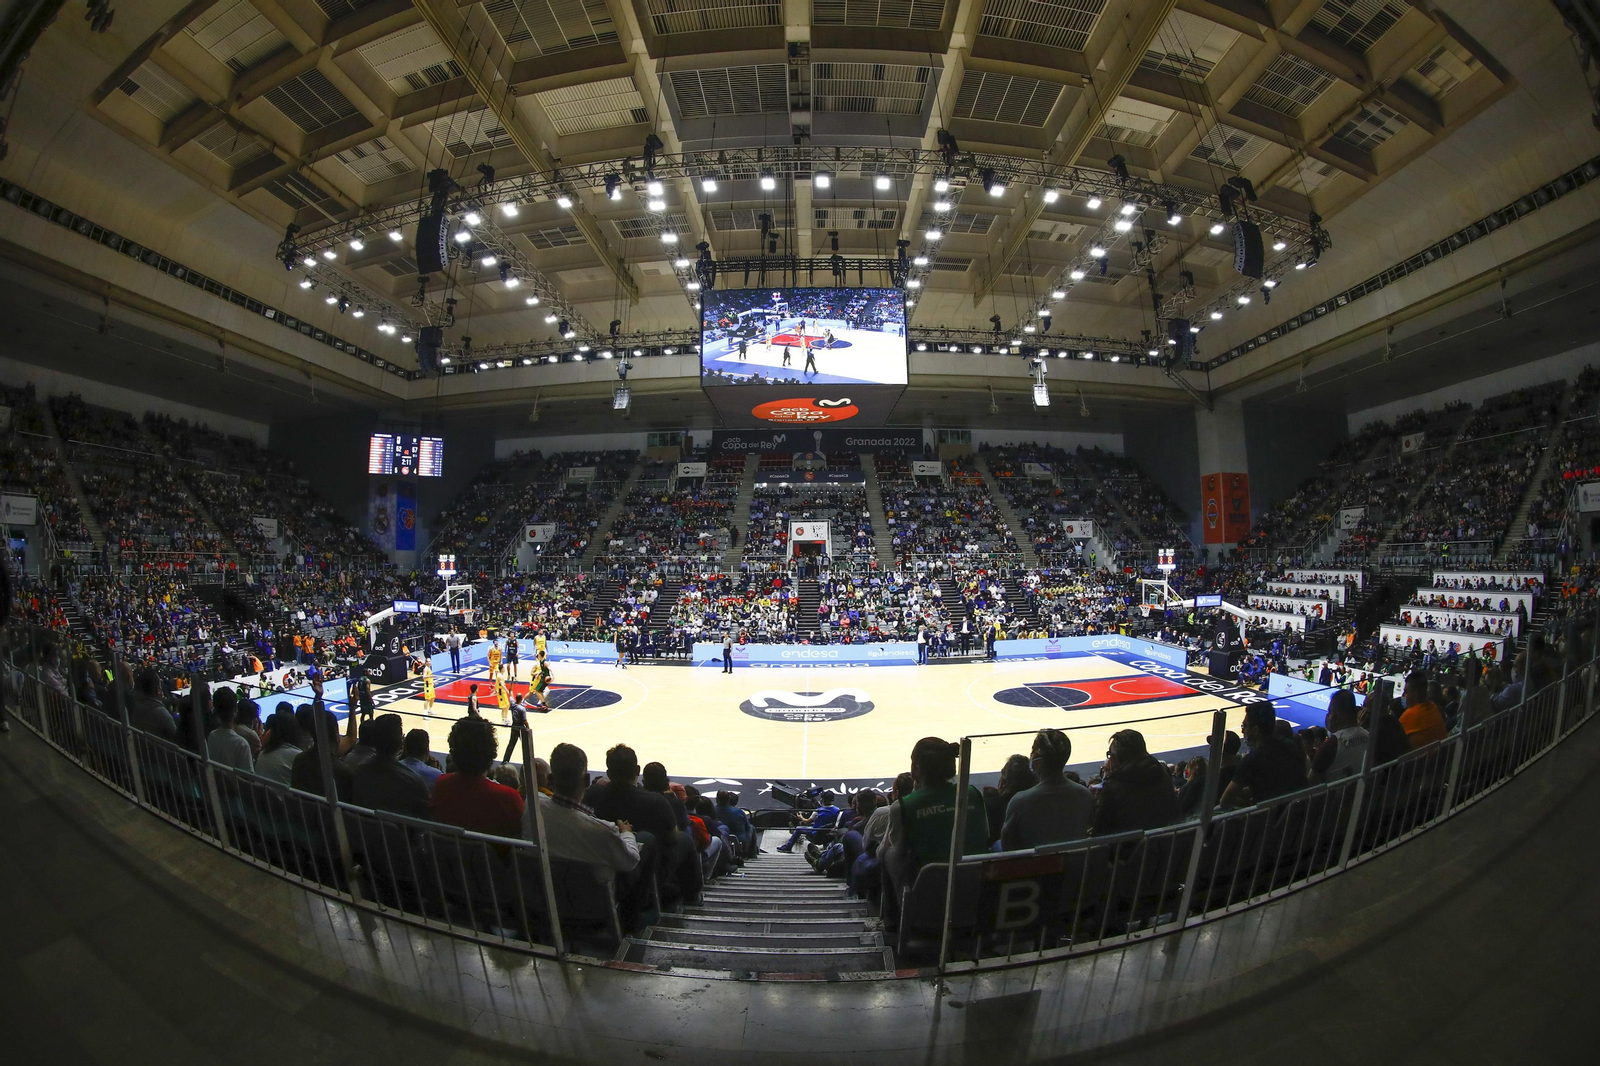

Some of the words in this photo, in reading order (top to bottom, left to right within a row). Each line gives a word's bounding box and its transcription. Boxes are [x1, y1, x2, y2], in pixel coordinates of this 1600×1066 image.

[770, 410, 824, 418] Copa
[721, 441, 748, 450] Copa
[760, 440, 778, 450] Rey
[845, 437, 892, 447] Granada
[893, 437, 916, 447] 2022
[1091, 636, 1131, 650] endesa
[781, 648, 839, 659] endesa
[1129, 660, 1191, 680] Copa
[1183, 676, 1238, 693] del
[916, 804, 946, 819] FIATC
[996, 880, 1041, 930] B
